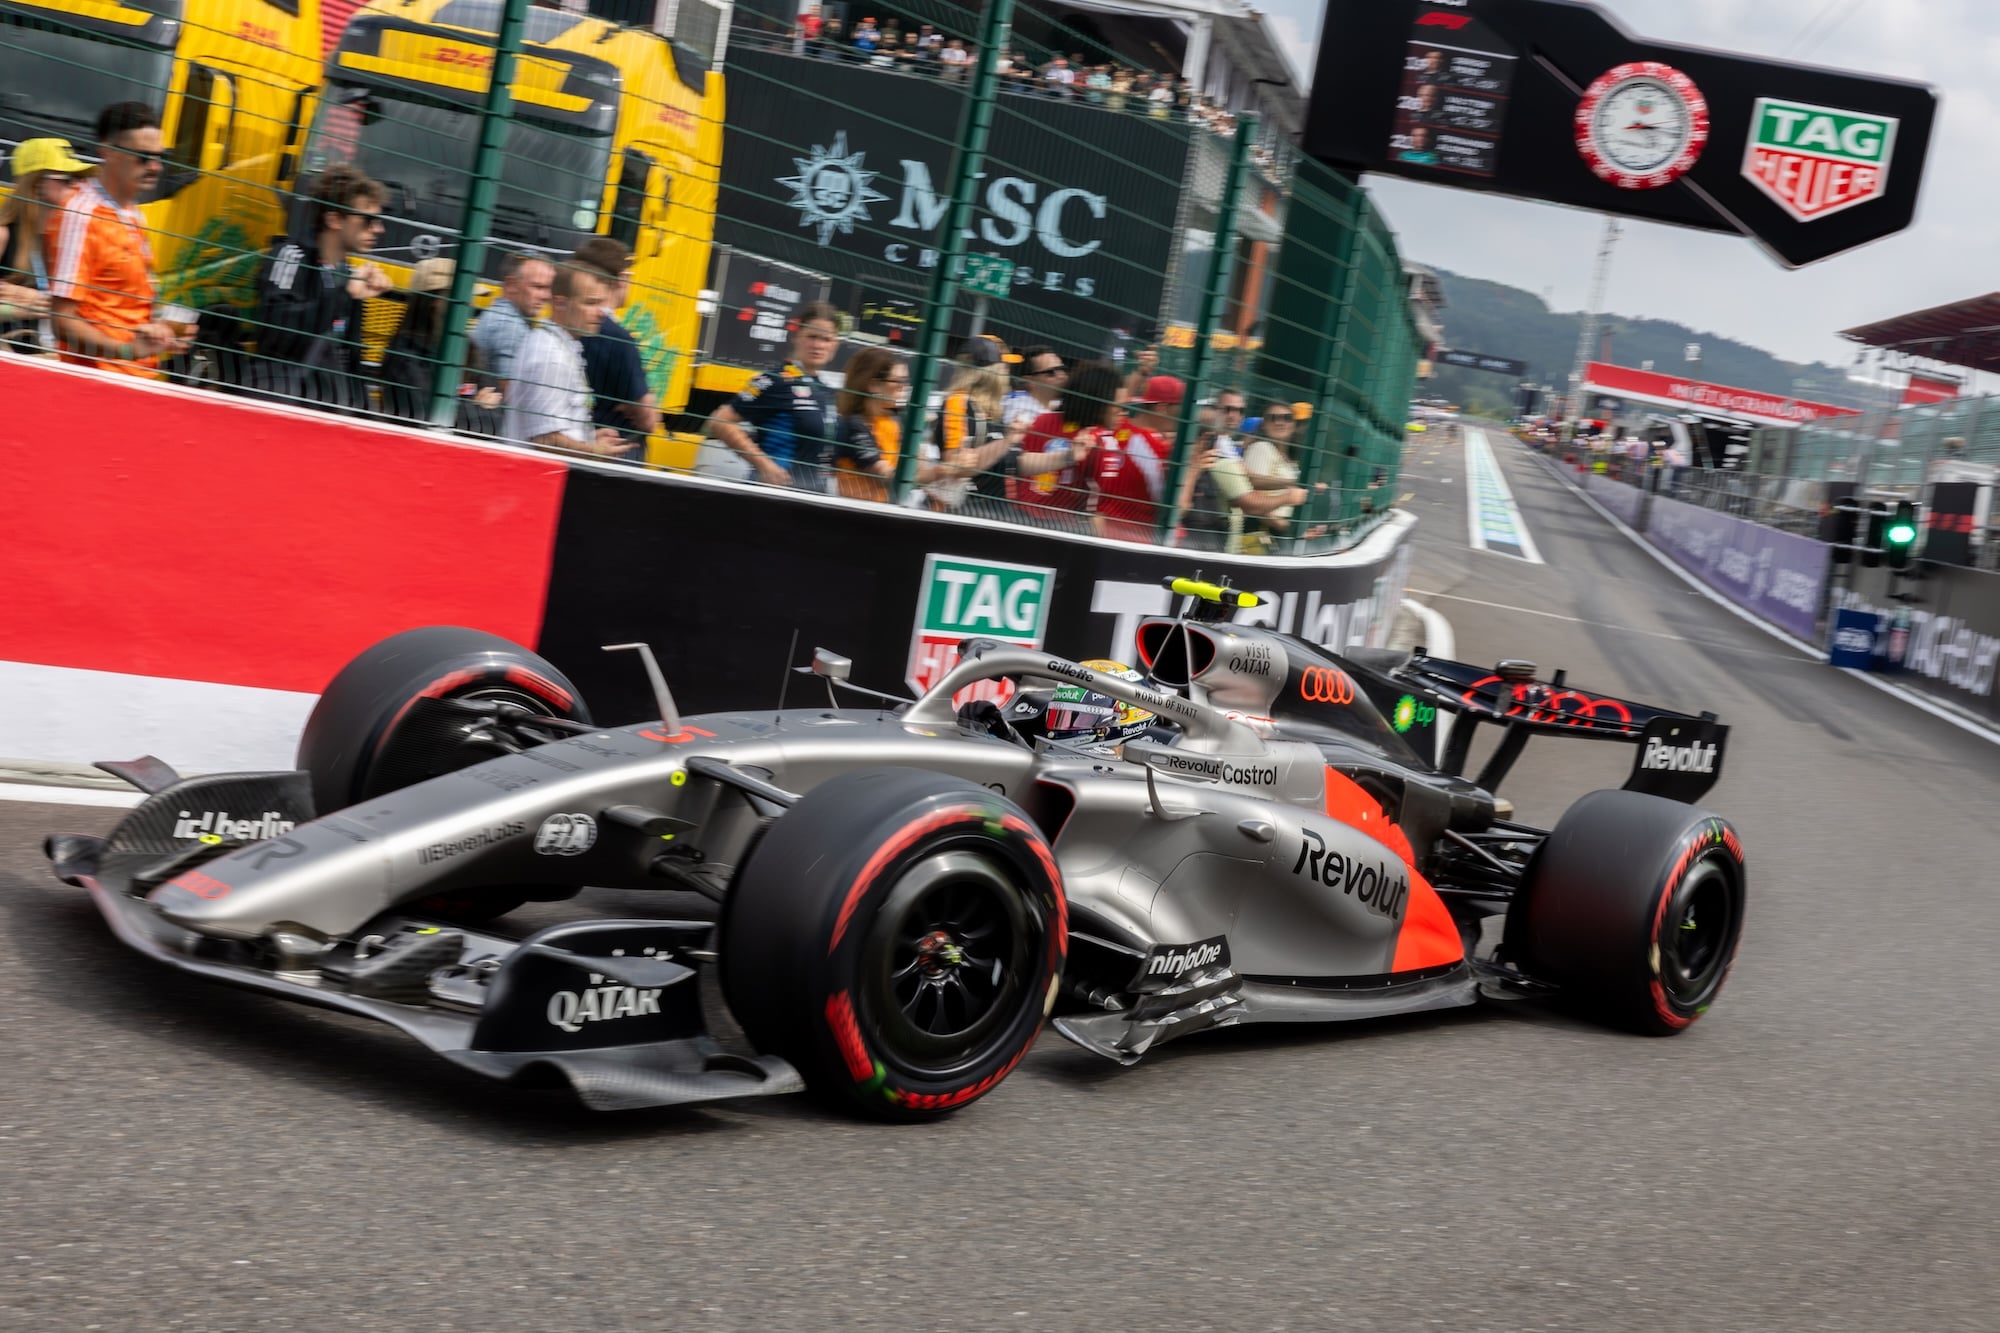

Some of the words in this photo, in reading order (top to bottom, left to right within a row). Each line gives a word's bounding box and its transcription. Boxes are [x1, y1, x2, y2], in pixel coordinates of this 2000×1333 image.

[1765, 107, 1883, 157] TAG
[1753, 150, 1878, 211] HEUER
[884, 243, 1096, 287] CRSES
[935, 568, 1042, 632] TAG
[1246, 642, 1271, 660] visit
[1047, 660, 1095, 683] Gillette
[1229, 656, 1271, 677] QATAR
[1026, 703, 1038, 715] bp
[1134, 688, 1163, 706] WORLD
[1165, 698, 1176, 710] OF
[1176, 703, 1199, 719] HYATT
[1415, 701, 1436, 728] bp
[1122, 722, 1147, 737] Revolut
[1169, 755, 1220, 776] Revolut
[1641, 736, 1717, 773] Revolut
[1222, 763, 1278, 785] Castrol
[214, 811, 295, 840] berlin
[1292, 826, 1407, 920] Revolut
[1147, 943, 1221, 979] ninjaOne
